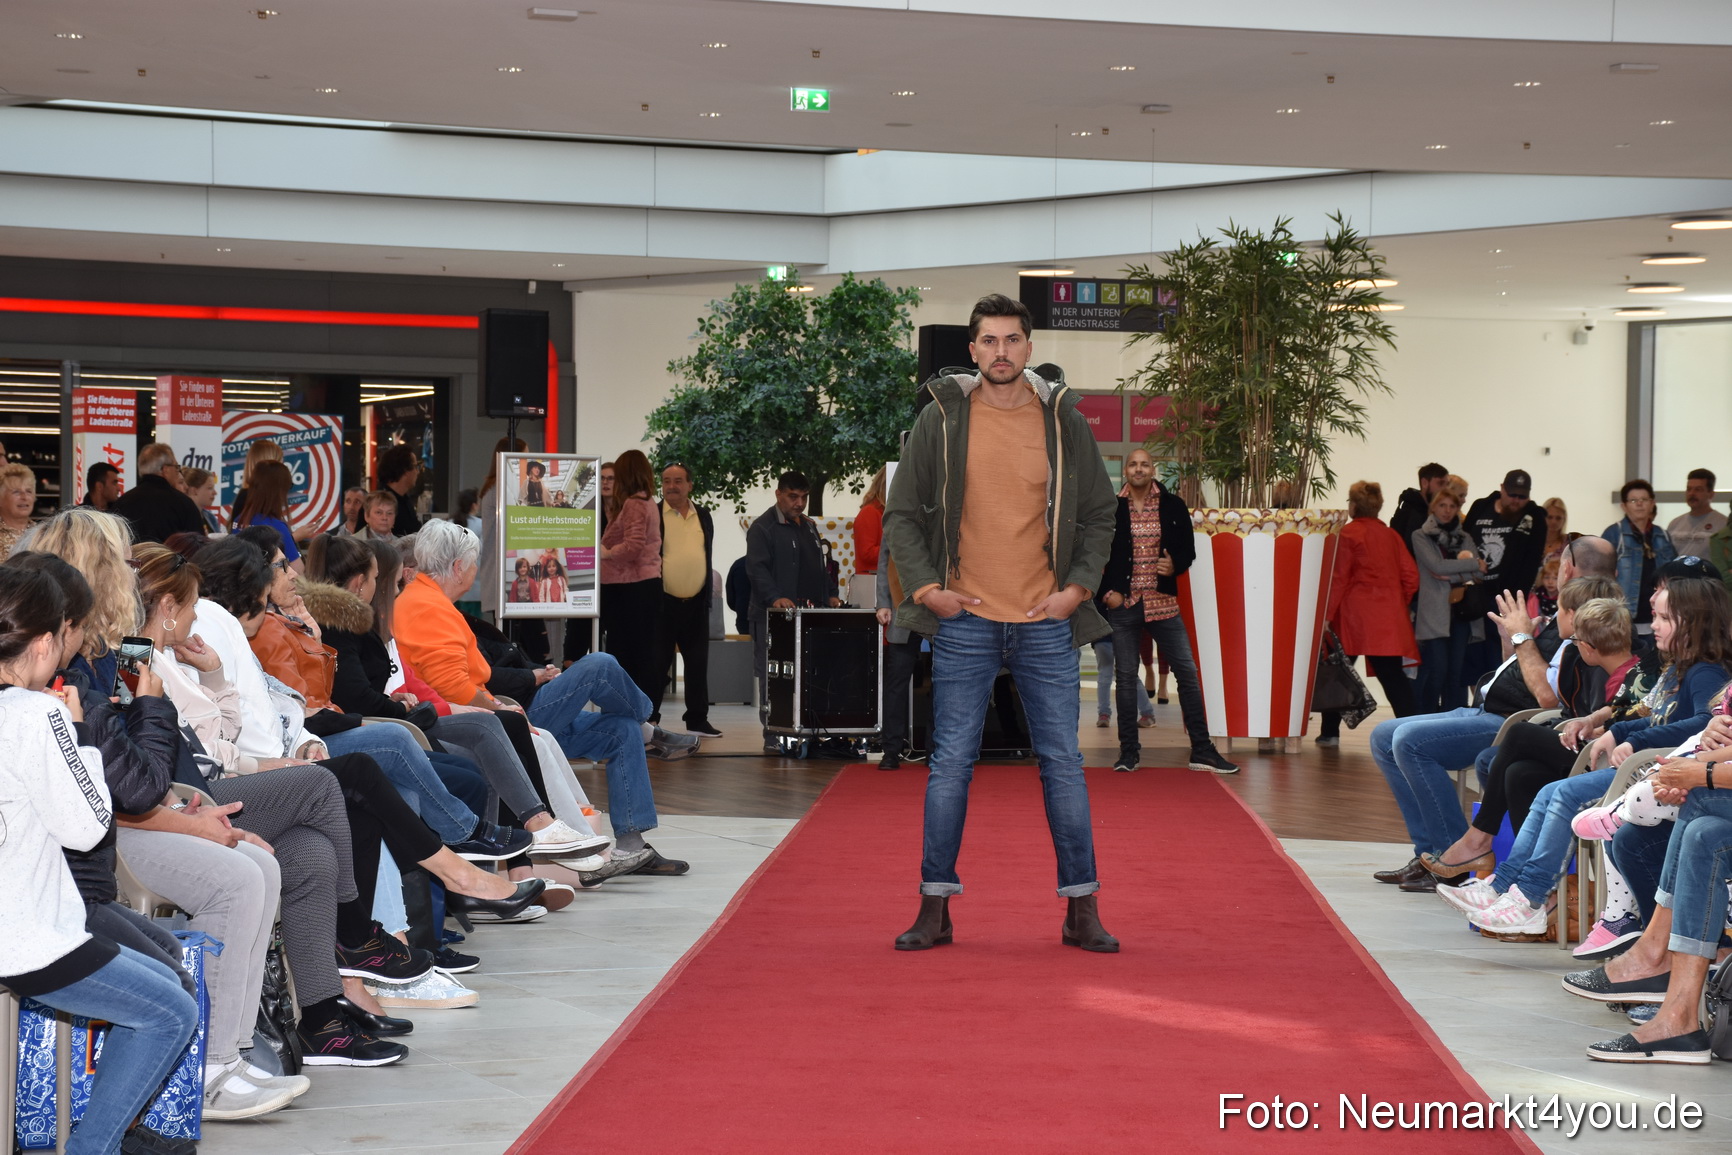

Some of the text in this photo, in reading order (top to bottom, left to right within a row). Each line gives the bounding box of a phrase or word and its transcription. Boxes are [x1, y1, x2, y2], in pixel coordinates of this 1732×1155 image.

[1052, 307, 1120, 318] IN DER UNTEREN
[1052, 319, 1120, 329] LADENSTRASSE
[180, 380, 188, 392] Sie
[206, 383, 215, 394] uns
[87, 394, 98, 404] Sie
[122, 396, 135, 406] uns
[180, 395, 185, 407] in
[186, 396, 195, 407] der
[88, 405, 135, 417] in der Oberen
[182, 410, 212, 422] Ladenstraße
[89, 416, 134, 428] Ladenstraße
[182, 447, 213, 471] dm
[510, 515, 591, 525] Lust auf Herbstmode?
